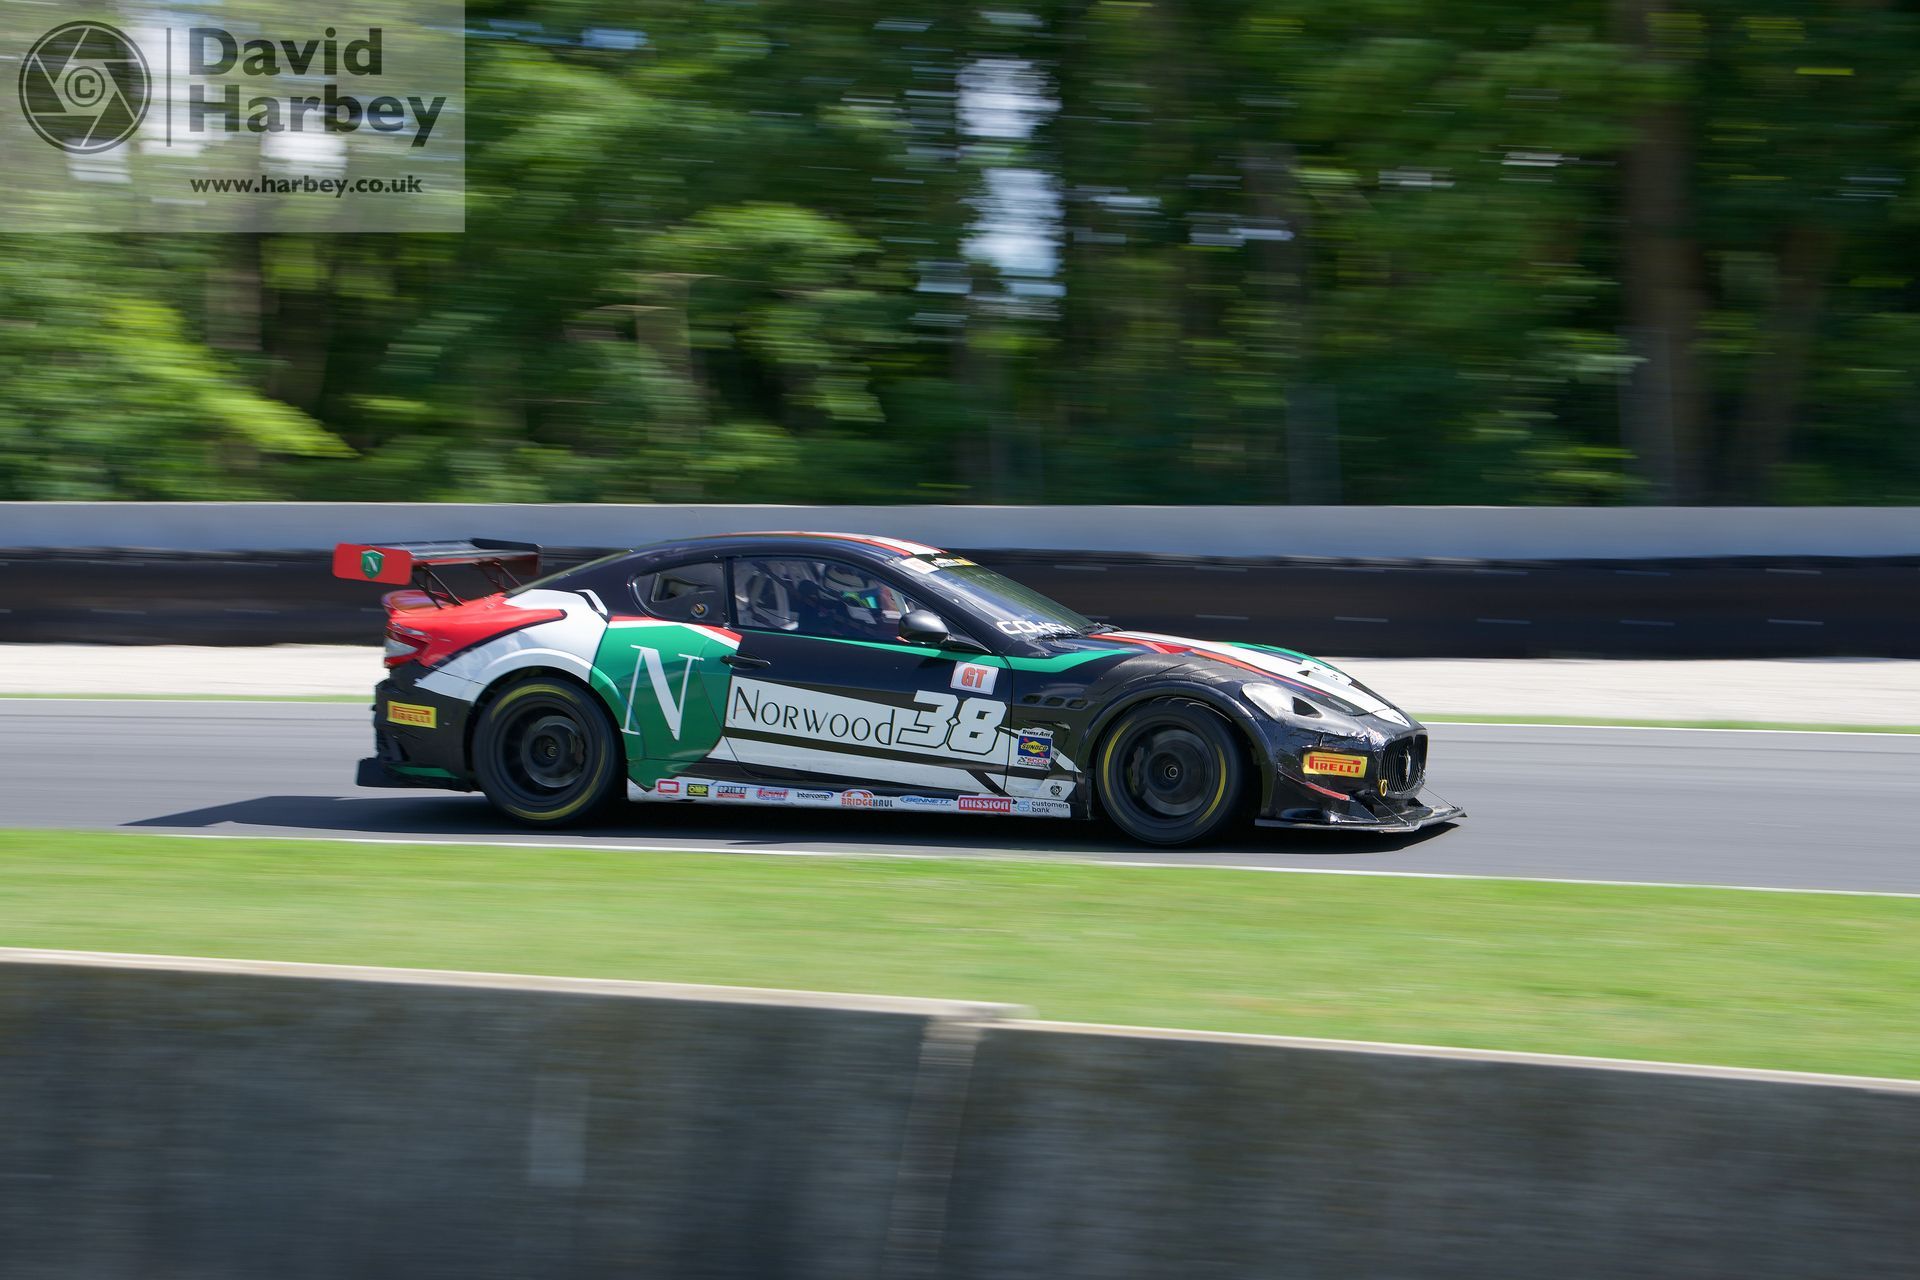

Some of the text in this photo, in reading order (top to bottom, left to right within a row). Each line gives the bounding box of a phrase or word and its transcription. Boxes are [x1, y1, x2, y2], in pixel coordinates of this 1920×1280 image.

[961, 667, 988, 689] GT
[620, 644, 705, 741] N
[392, 705, 431, 723] PIRELLI
[896, 691, 1006, 755] 38
[1021, 743, 1048, 752] SUNOCO
[1309, 755, 1361, 774] PIRELLI
[841, 797, 893, 807] BRIDGEHAUL
[906, 796, 950, 804] BENNETT
[1031, 801, 1069, 809] customers
